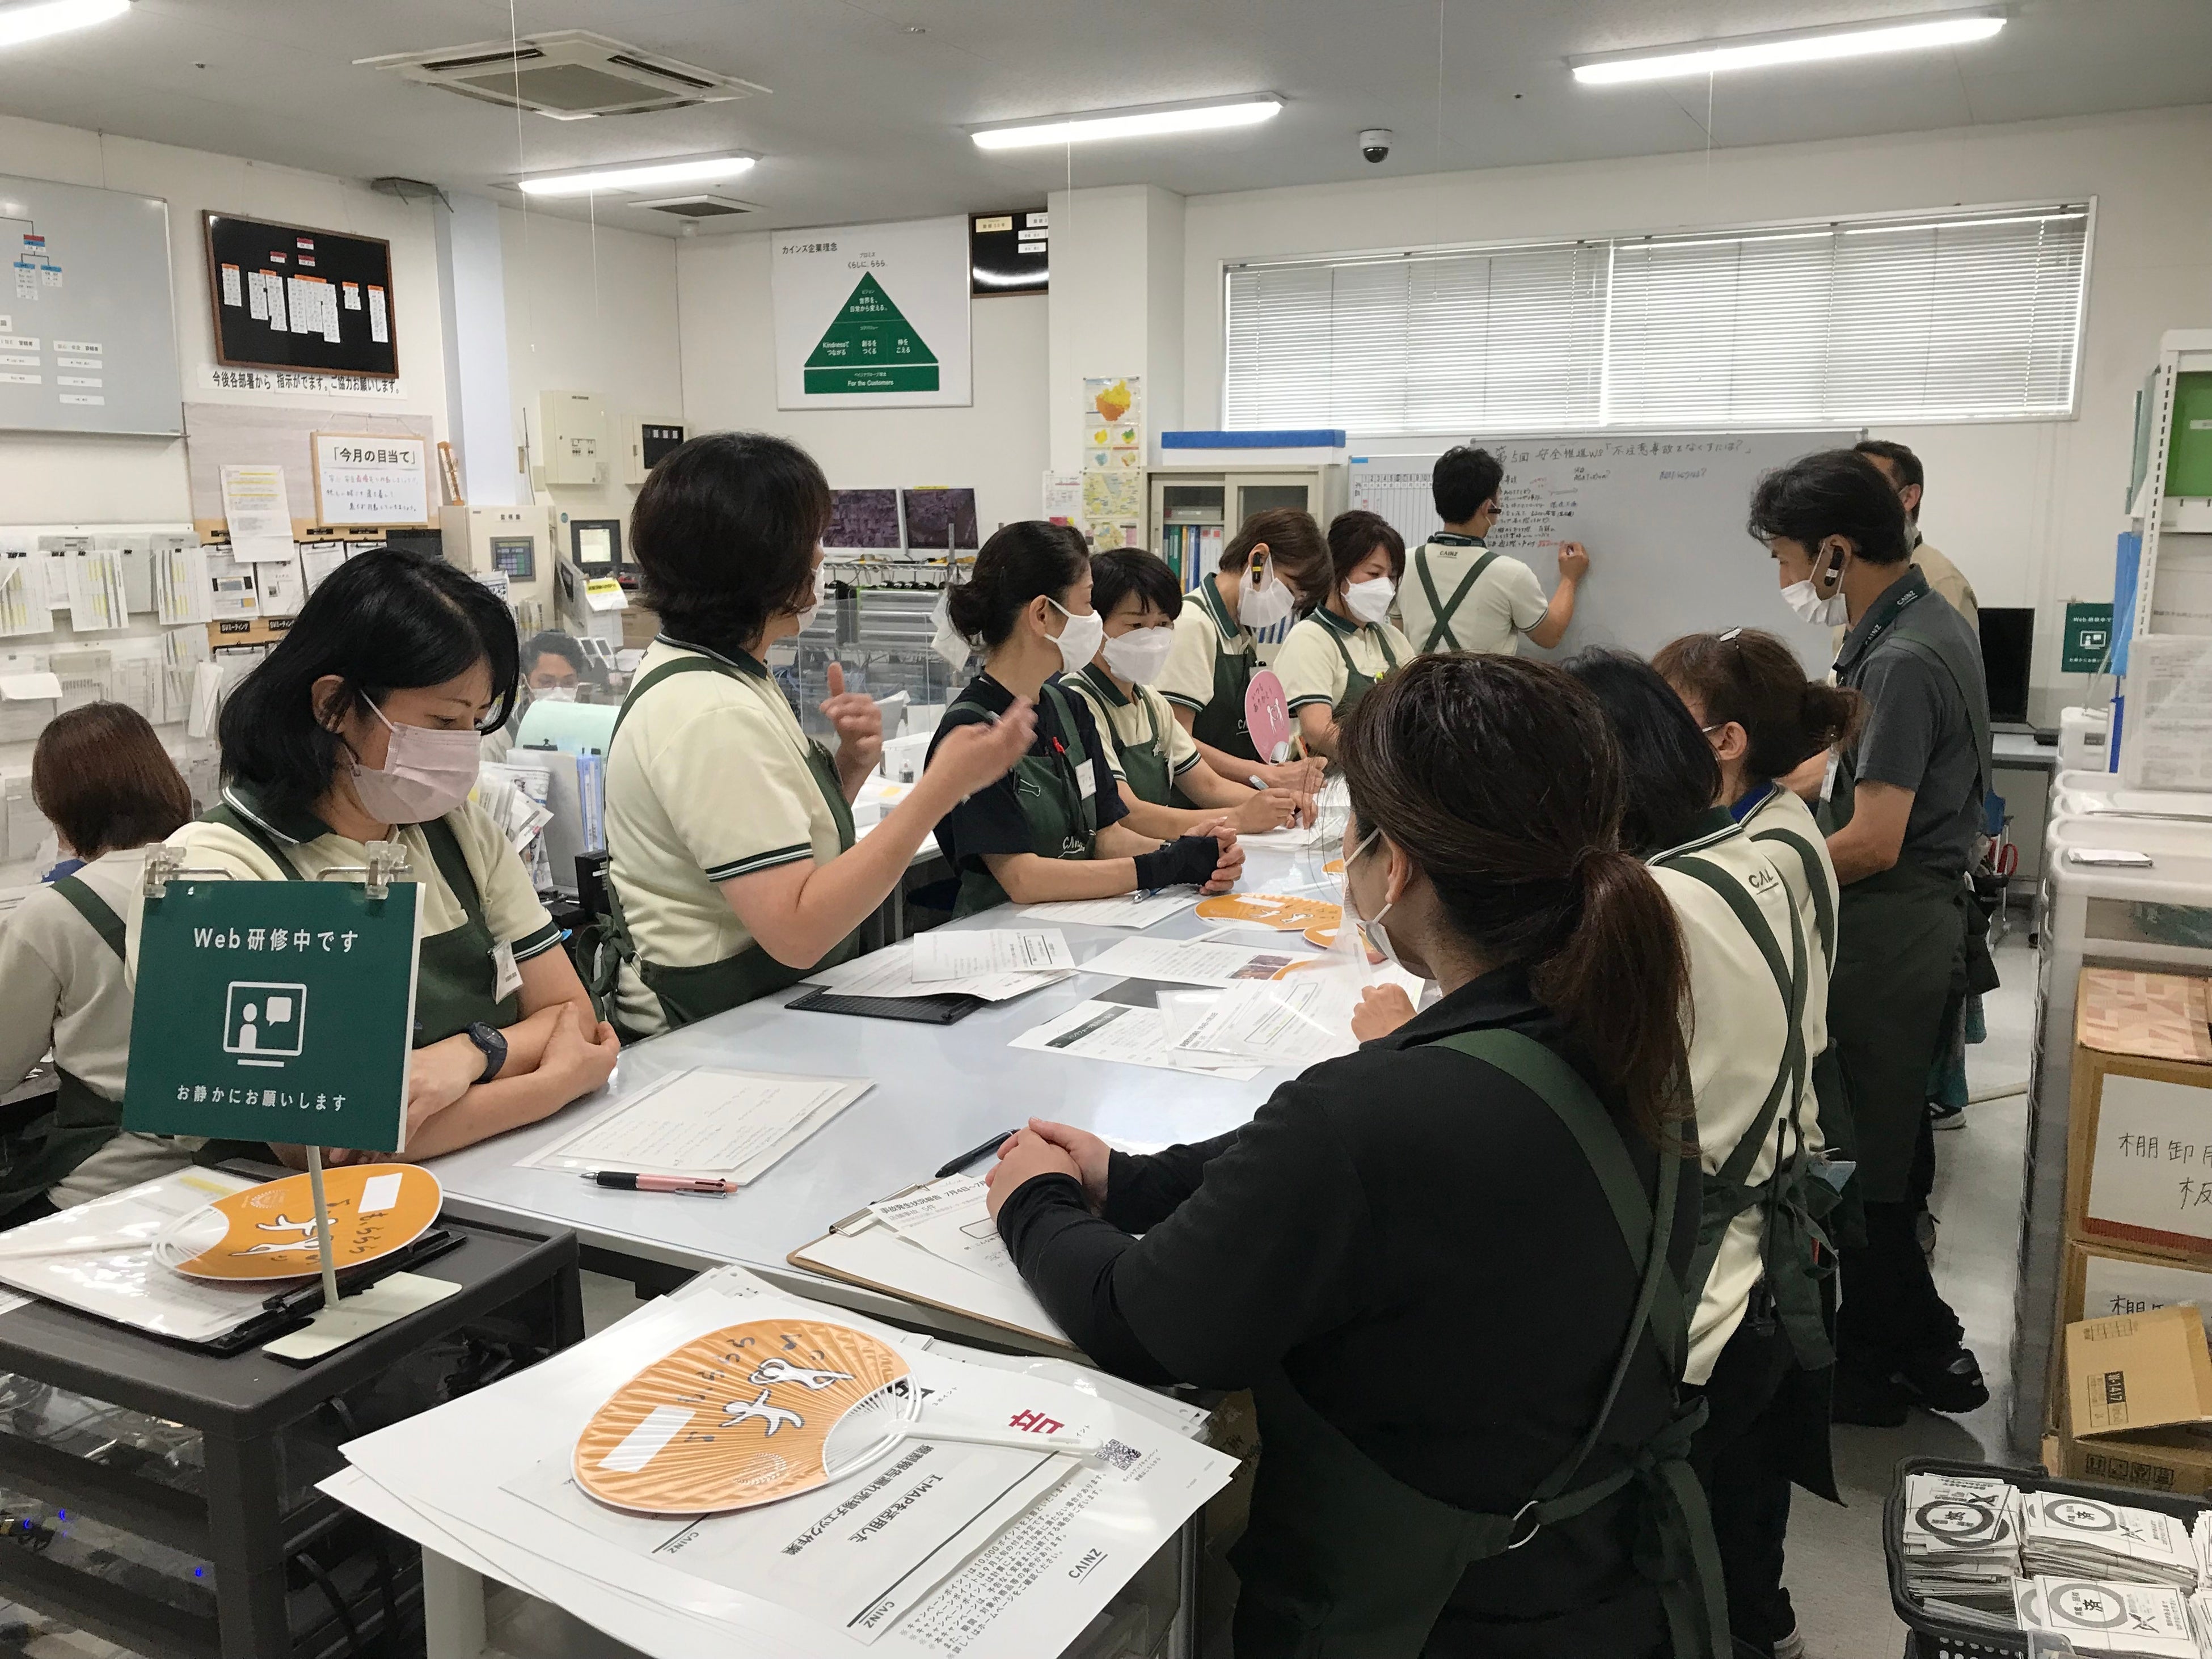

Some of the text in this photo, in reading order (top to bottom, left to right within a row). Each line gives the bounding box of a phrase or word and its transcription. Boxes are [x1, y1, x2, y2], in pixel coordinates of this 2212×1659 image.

[782, 242, 838, 255] カインズ企業理念
[212, 371, 271, 389] 今後各部署から
[334, 446, 415, 465] 「今月の目当て」
[1897, 590, 1916, 605] CAINZ
[193, 926, 358, 953] Web研修中です
[176, 1084, 347, 1111] お静かにお願いします
[879, 1194, 943, 1217] 事故発生状況報告
[780, 1445, 932, 1556] 棚割報告漏れ売場チェック作業
[847, 1475, 943, 1543] I-MAPを活用した
[1067, 1548, 1103, 1580] CAINZ
[868, 1600, 896, 1628] CAINZ
